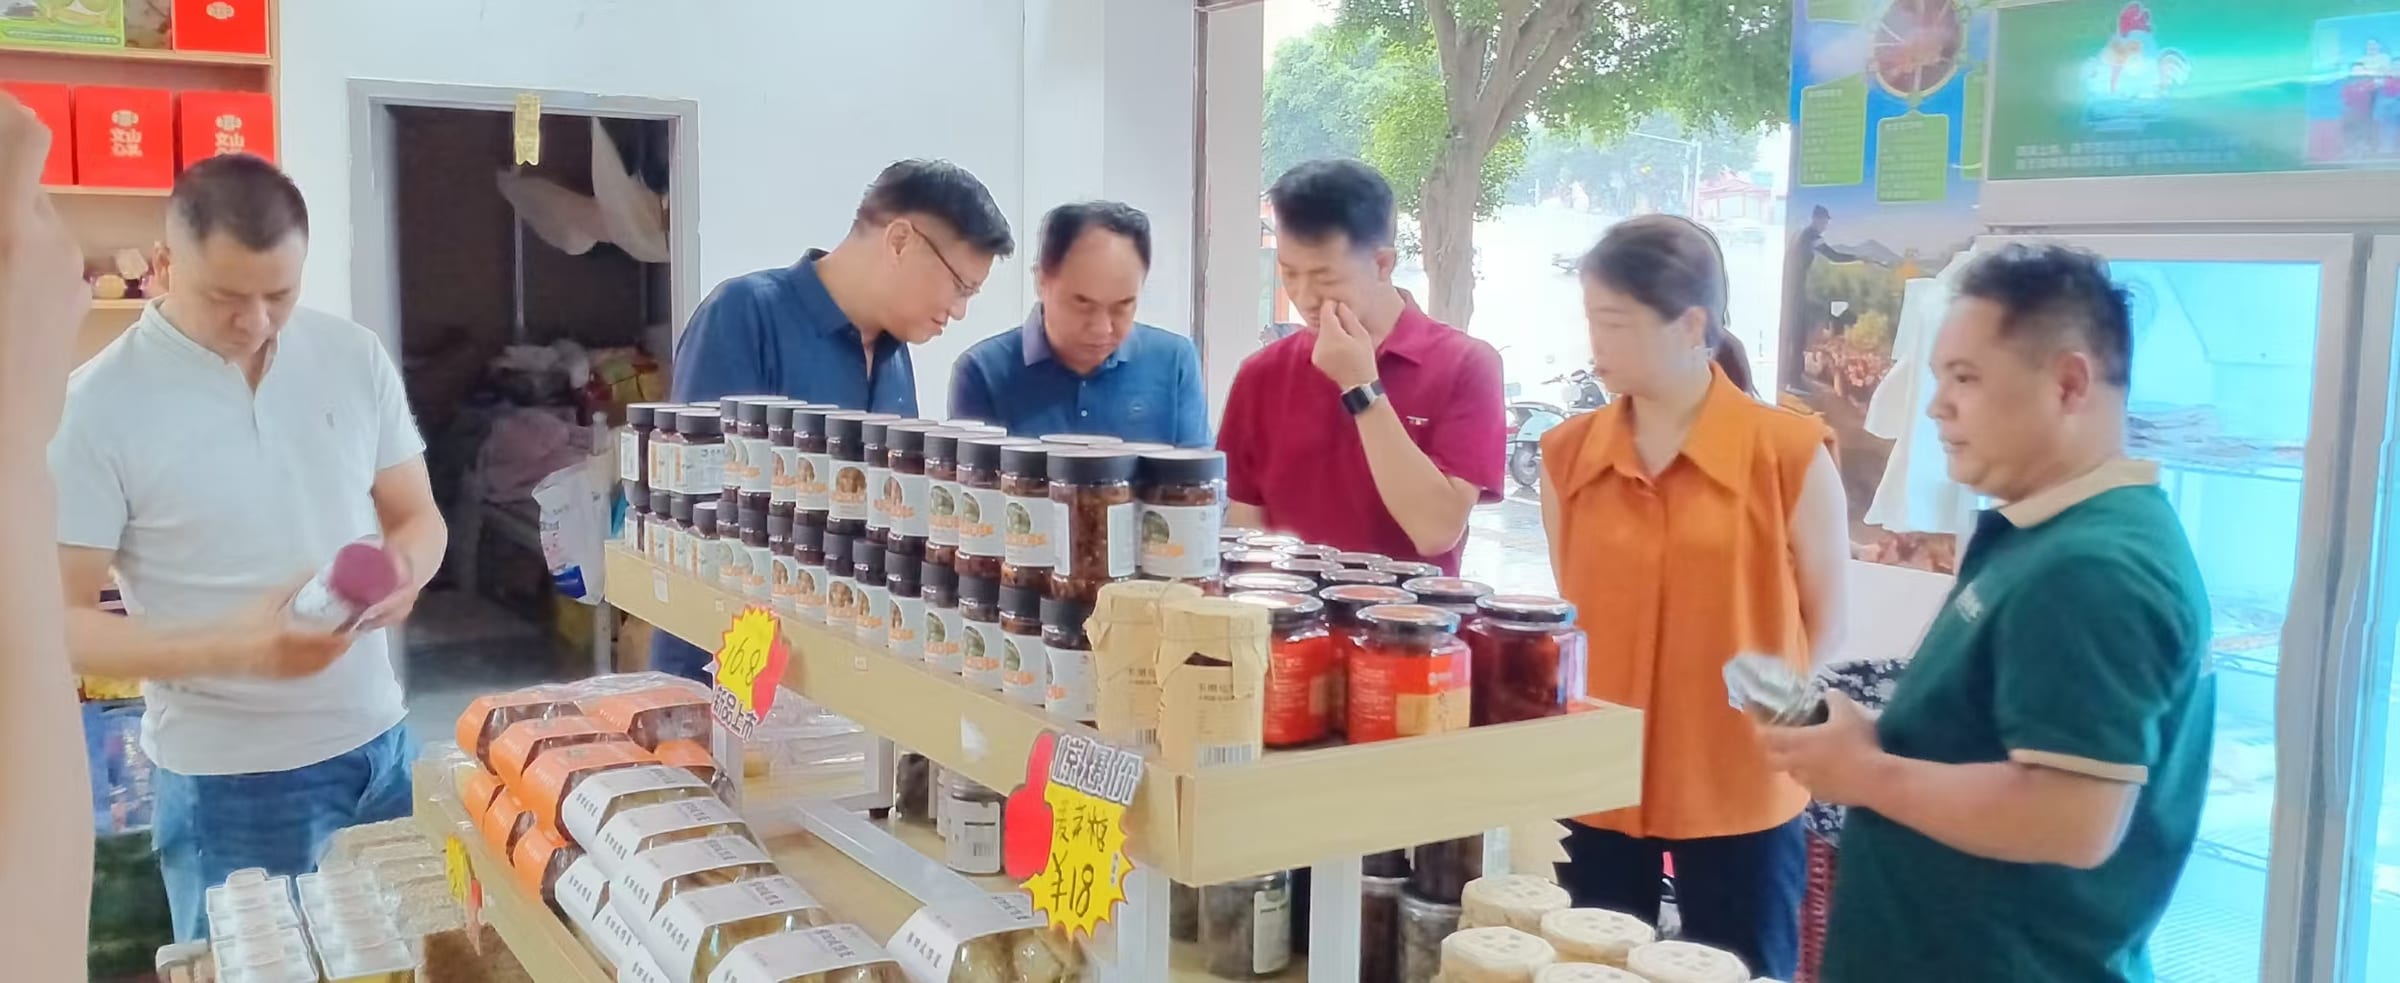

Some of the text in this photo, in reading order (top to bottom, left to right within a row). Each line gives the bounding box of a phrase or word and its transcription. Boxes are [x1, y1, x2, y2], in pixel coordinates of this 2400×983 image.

[723, 636, 762, 687] 16.8
[712, 685, 758, 741] 新品上市
[1053, 736, 1142, 804] 惊爆价
[1051, 850, 1095, 918] ¥18
